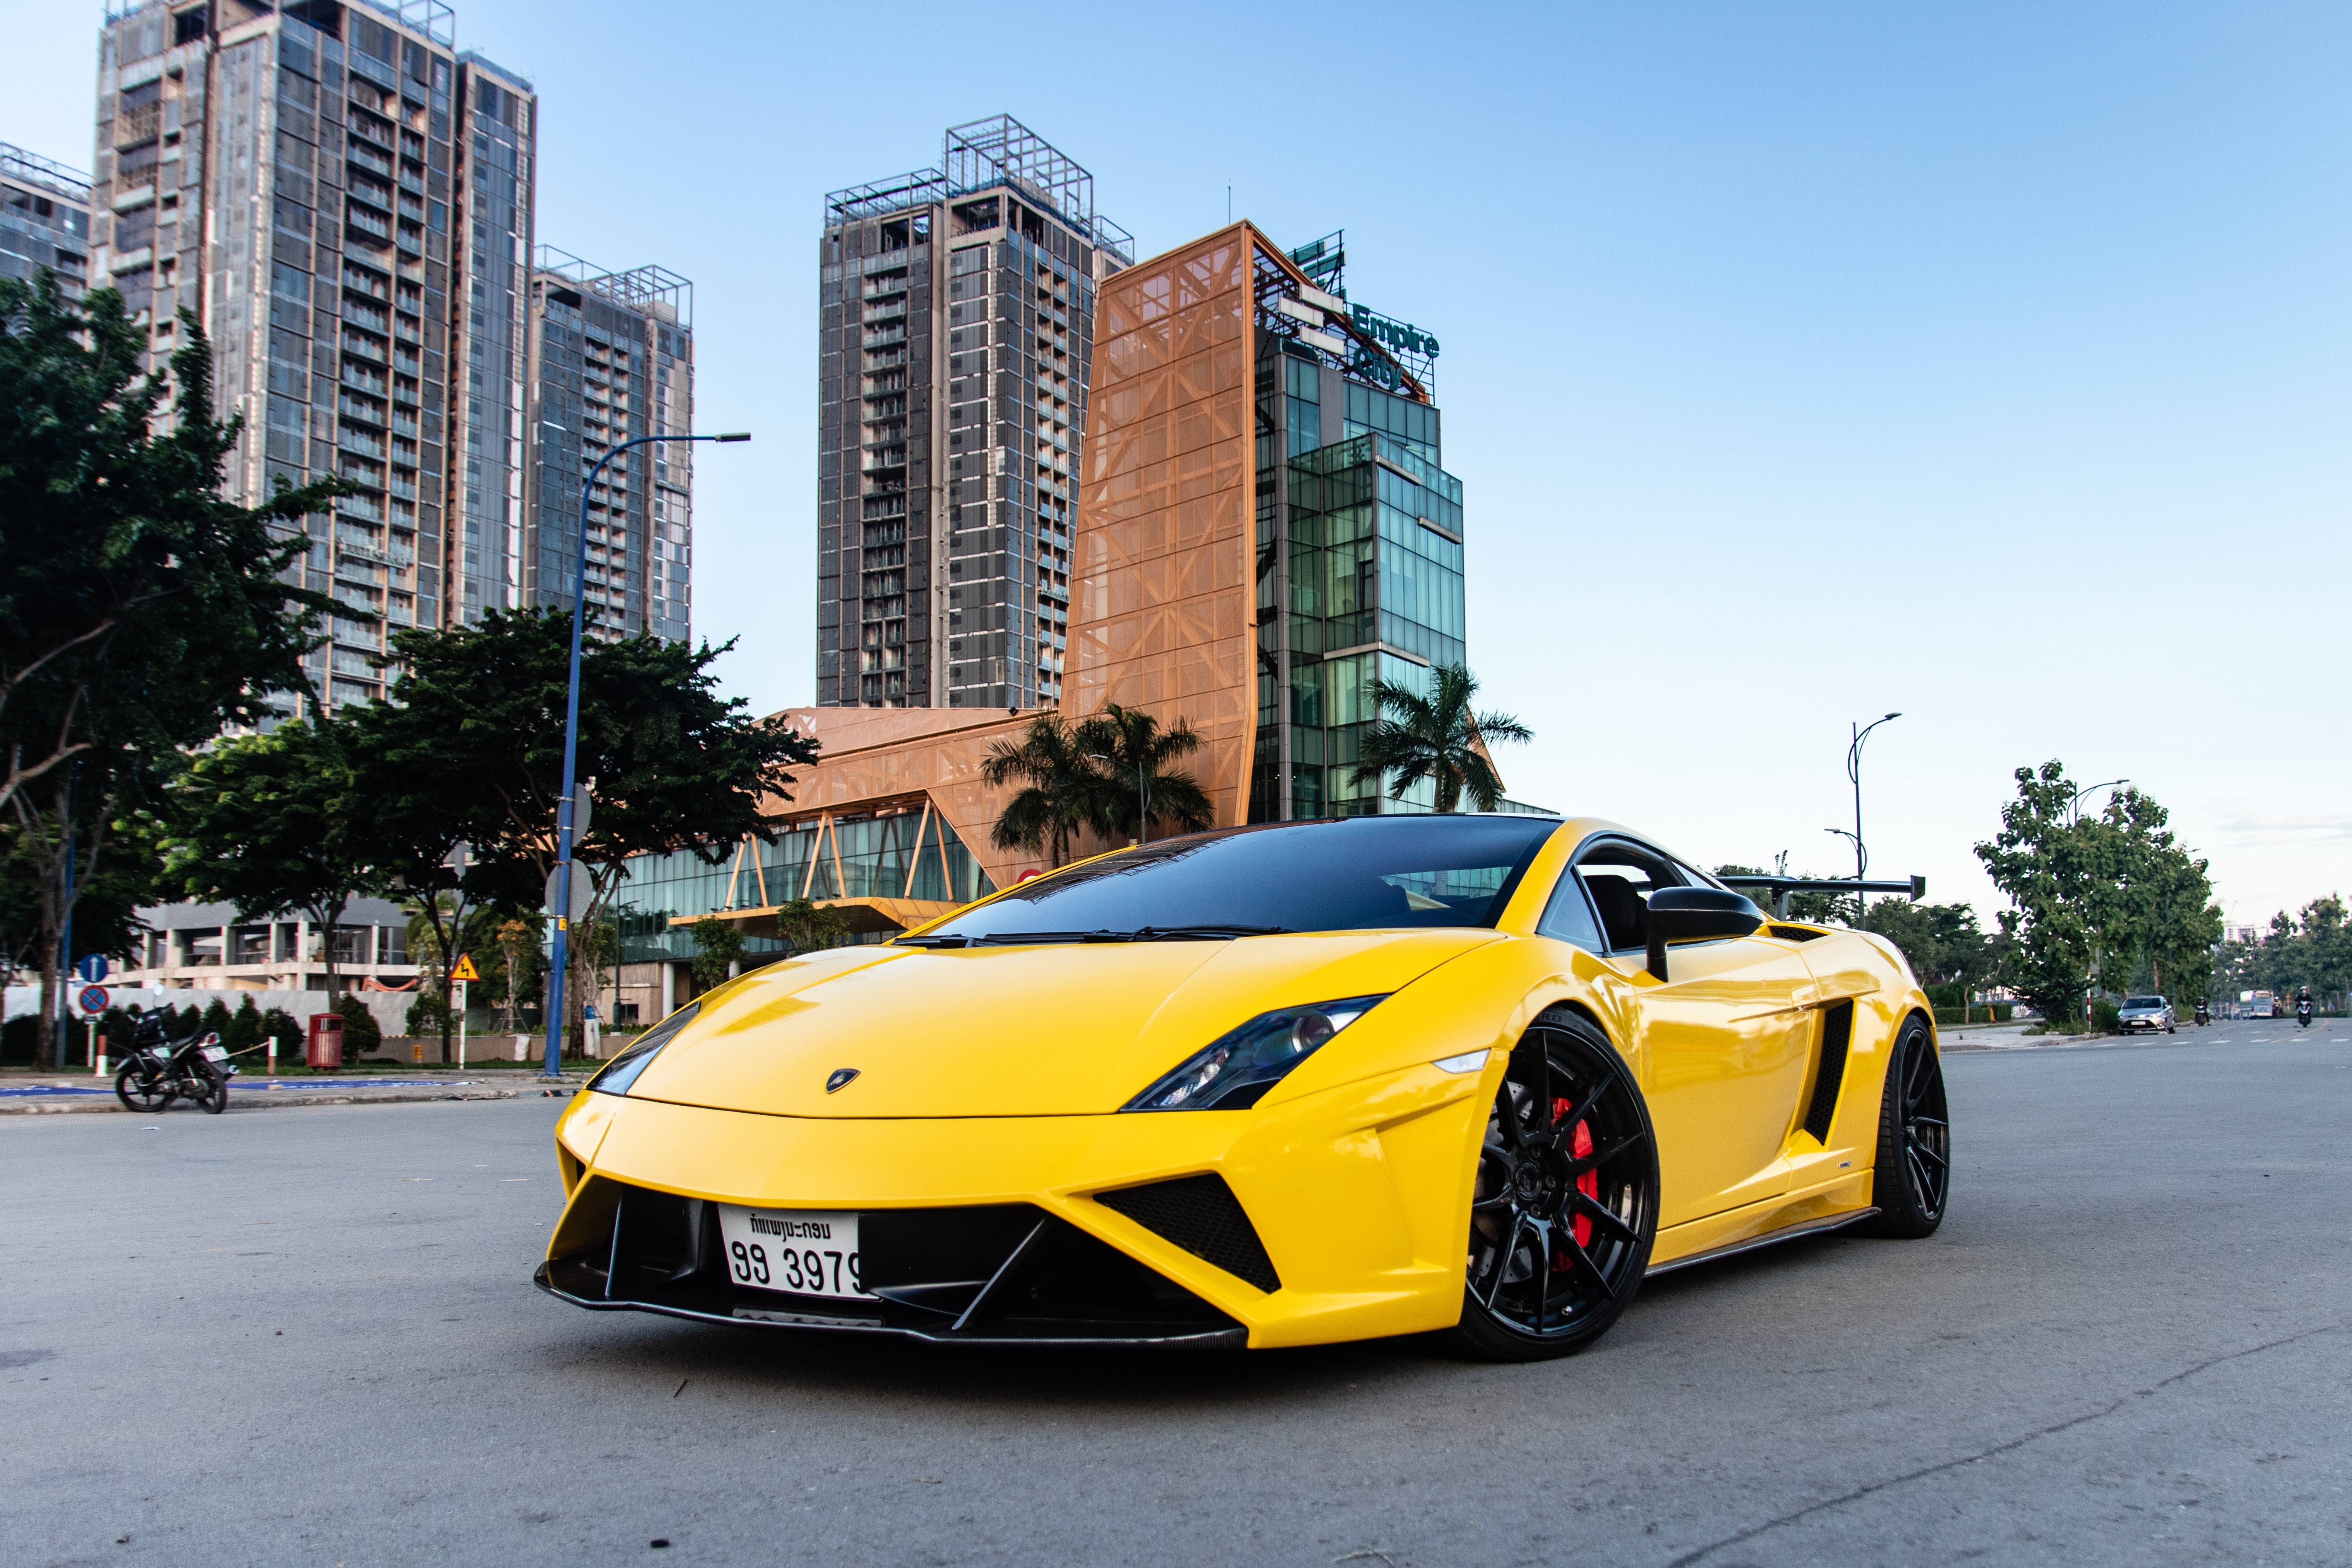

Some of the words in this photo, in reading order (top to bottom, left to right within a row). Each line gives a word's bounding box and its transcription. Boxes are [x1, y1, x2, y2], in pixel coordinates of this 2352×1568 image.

[1353, 303, 1440, 358] Empire
[1354, 346, 1402, 392] City
[732, 1241, 770, 1284] 99
